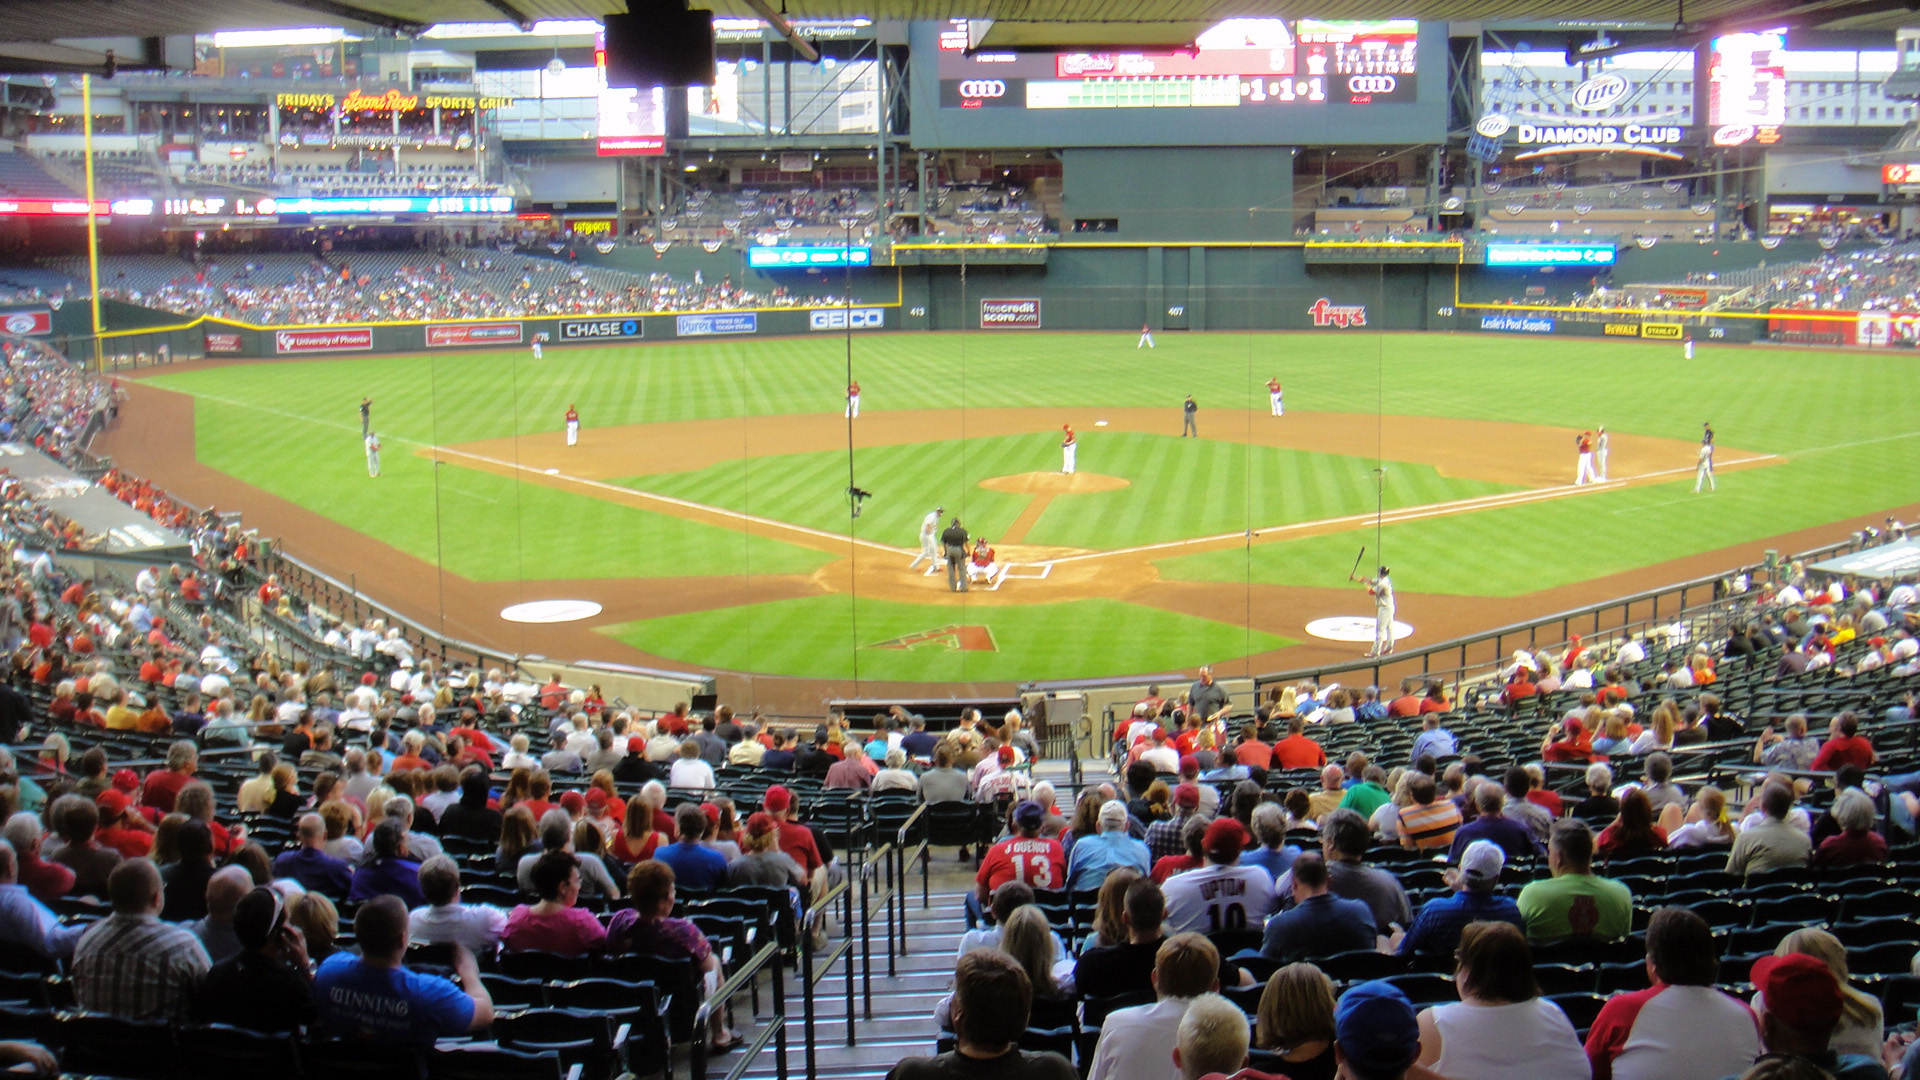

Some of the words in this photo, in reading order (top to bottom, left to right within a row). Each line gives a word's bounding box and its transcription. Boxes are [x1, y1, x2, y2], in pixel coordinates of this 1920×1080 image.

[1250, 77, 1266, 101] 1
[1279, 77, 1296, 101] 1
[1309, 77, 1325, 101] 1
[276, 93, 335, 107] FRIDAY'S
[425, 96, 475, 109] SPORTS
[479, 96, 514, 110] GRILL
[1518, 125, 1617, 143] DIAMOND
[1623, 125, 1681, 143] CLUB
[910, 307, 925, 317] 413
[983, 303, 1035, 314] freecredit
[1168, 306, 1185, 316] 407
[1437, 307, 1453, 316] 413
[812, 310, 883, 328] GEICO
[983, 313, 1037, 322] score.com
[1505, 318, 1521, 330] Pool
[566, 322, 620, 338] CHASE
[1010, 854, 1051, 887] 13
[1207, 902, 1246, 931] 10
